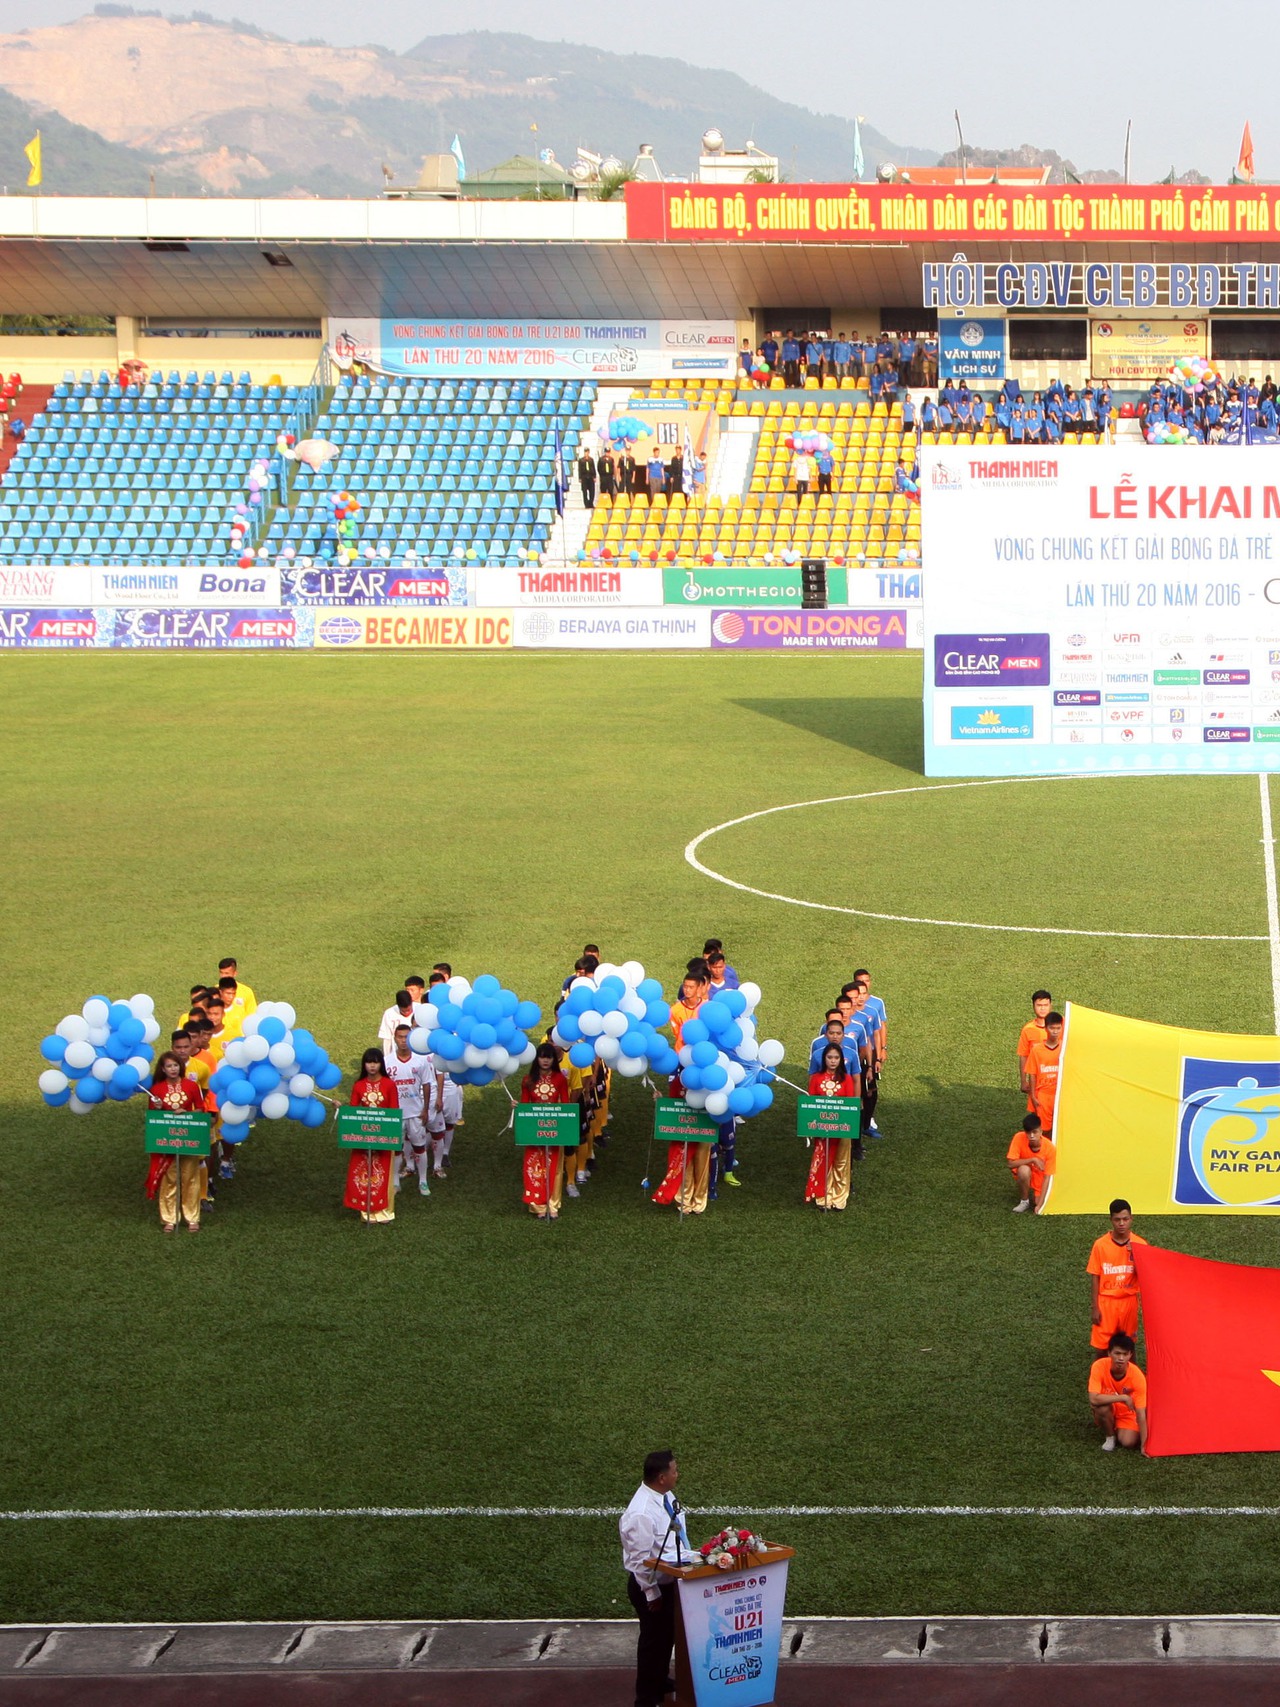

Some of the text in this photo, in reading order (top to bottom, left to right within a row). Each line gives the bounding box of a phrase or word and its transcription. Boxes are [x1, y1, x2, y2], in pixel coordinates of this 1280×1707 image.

[670, 190, 717, 229] ĐẢNG
[723, 192, 752, 237] BỘ,
[757, 192, 810, 230] CHÍNH
[815, 188, 876, 232] QUYỀN,
[881, 193, 927, 230] NHÂN
[933, 193, 967, 230] DÂN
[973, 193, 1007, 231] CÁC
[1013, 193, 1047, 230] DÂN
[1052, 193, 1085, 237] TỘC
[1089, 193, 1144, 231] THÀNH
[1151, 189, 1184, 231] PHỐ
[1190, 188, 1229, 231] CẨM
[1236, 192, 1269, 231] PHẢ
[922, 253, 985, 317] HỘI
[996, 263, 1073, 308] CĐV
[1086, 263, 1157, 308] CLB
[1169, 263, 1221, 308] BĐ
[665, 331, 705, 344] CLEAR
[465, 348, 482, 365] 20
[524, 348, 555, 365] 2016
[944, 348, 1000, 360] VĂN MINH
[953, 364, 997, 375] LỊCH SỰ
[1090, 473, 1137, 519] LỄ
[1148, 486, 1251, 518] KHAI
[1042, 538, 1093, 560] CHUNG
[199, 573, 266, 593] Bona
[297, 568, 447, 597] CLEAR MEN
[1137, 584, 1156, 607] 20
[1205, 583, 1241, 607] 2016
[42, 623, 93, 636] MEN
[134, 611, 294, 638] CLEAR MEN
[365, 617, 510, 645] BECAMEX IDC
[559, 620, 622, 633] BERJAYA
[625, 620, 650, 633] GIA
[748, 616, 905, 635] TON DONG A
[783, 637, 878, 646] MADE IN VIETNAM
[1113, 634, 1140, 644] VFM
[944, 652, 1038, 670] CLEAR MEN
[1211, 1149, 1240, 1159] MY
[1210, 1162, 1249, 1172] FAIR
[735, 1611, 763, 1631] U.21
[709, 1663, 746, 1681] CLEAR
[748, 1669, 761, 1680] CUP
